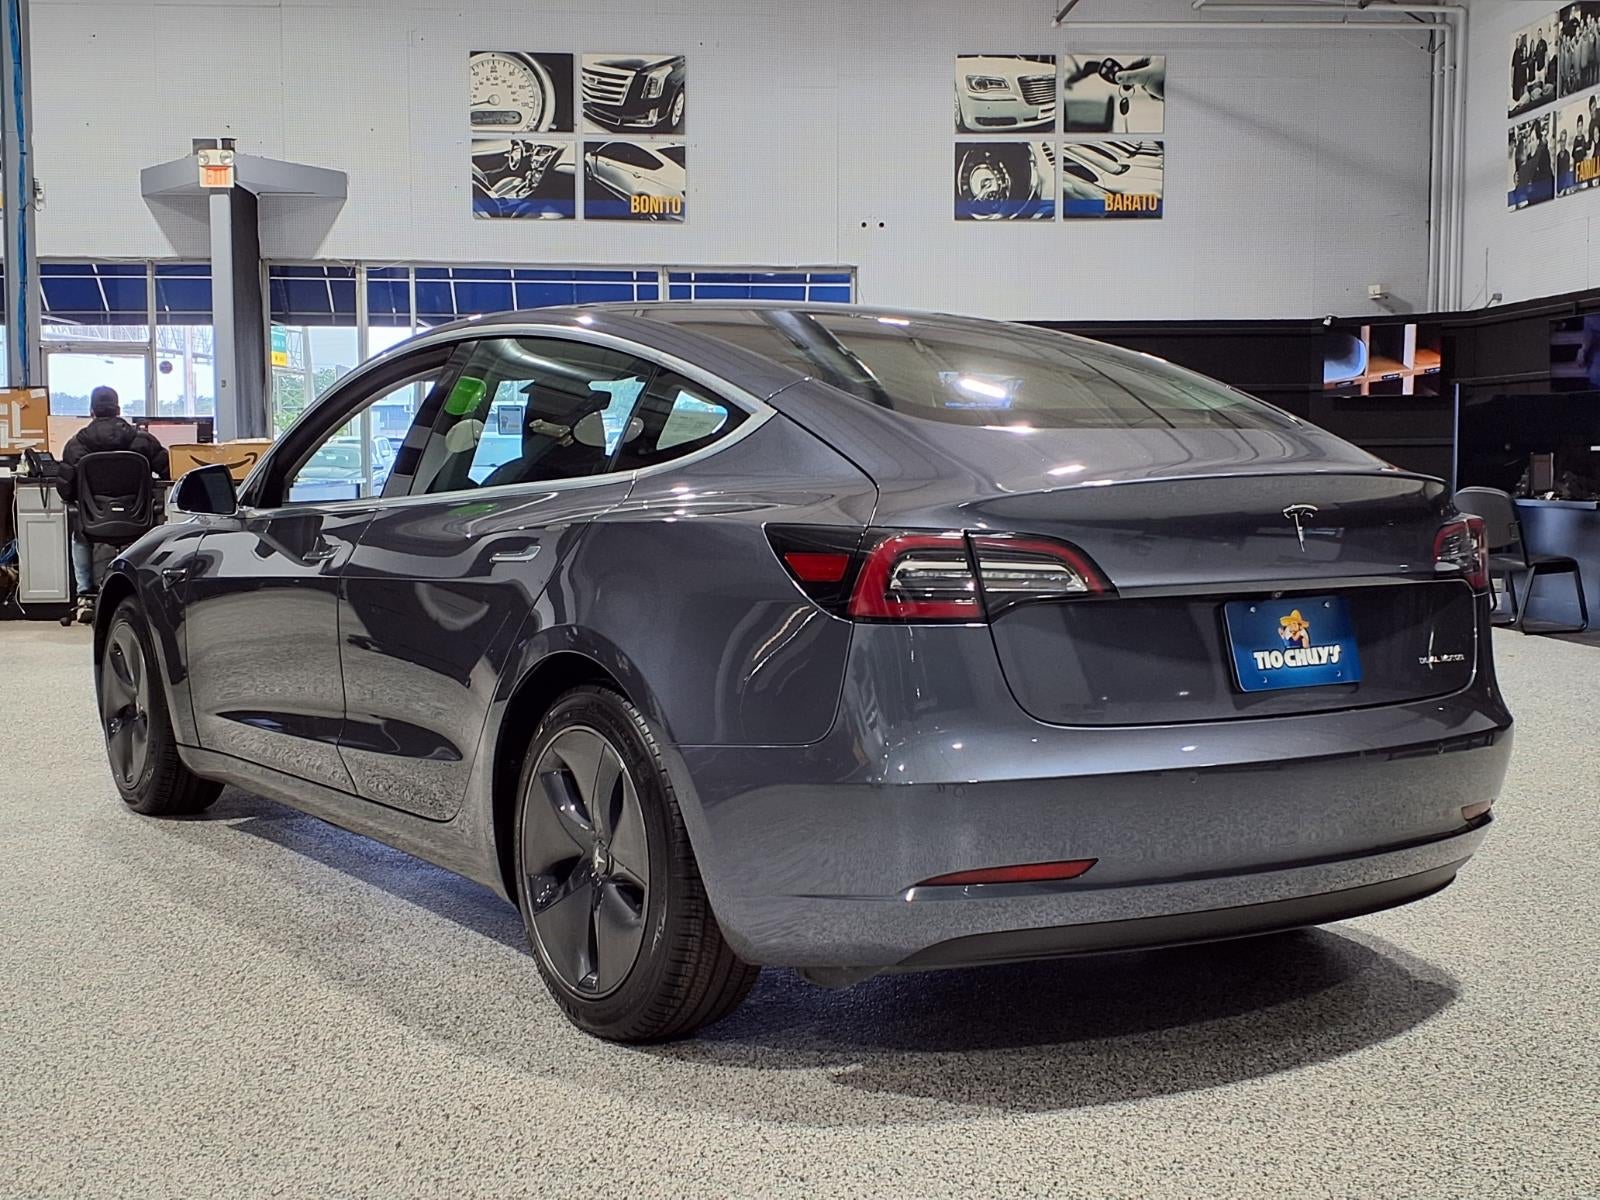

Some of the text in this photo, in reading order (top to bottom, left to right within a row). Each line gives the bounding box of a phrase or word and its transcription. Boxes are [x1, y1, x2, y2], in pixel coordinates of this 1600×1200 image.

[206, 168, 228, 185] EXIT
[1575, 155, 1600, 183] FAMILI
[630, 194, 682, 214] BONITO
[1104, 193, 1158, 212] BARATO
